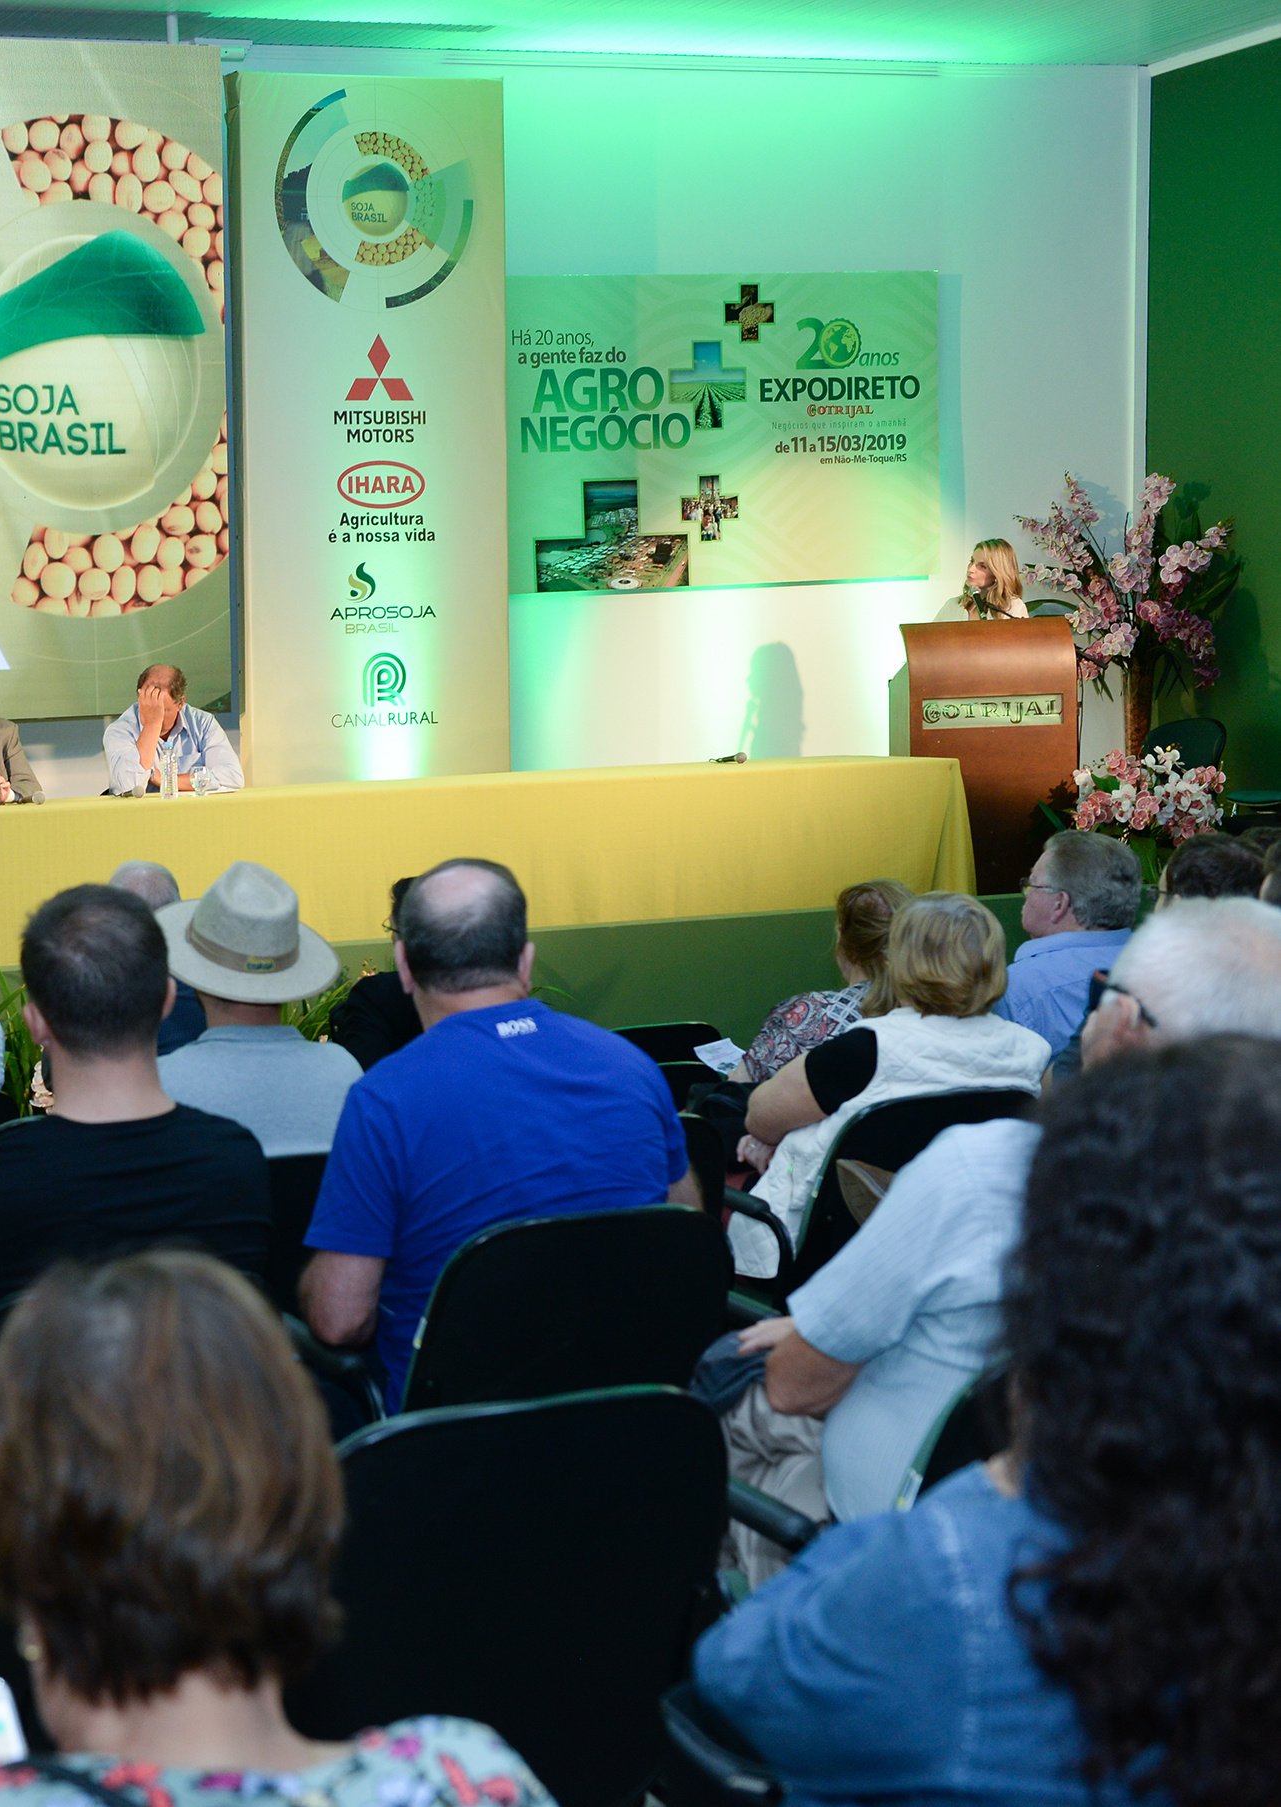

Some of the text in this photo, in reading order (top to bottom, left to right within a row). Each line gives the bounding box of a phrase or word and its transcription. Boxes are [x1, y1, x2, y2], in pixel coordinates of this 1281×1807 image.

[350, 202, 375, 211] SOJA
[352, 212, 387, 222] BRASIL
[511, 330, 595, 347] Há 20 anos,
[796, 317, 900, 370] 20 anos
[518, 346, 627, 368] a gente faz do
[532, 366, 665, 413] AGRO
[759, 375, 921, 403] EXPODIRETO
[333, 411, 426, 425] MITSUBISHI
[520, 406, 691, 453] NEGÓCIO
[772, 421, 808, 432] Negócios
[811, 422, 826, 431] que
[829, 421, 865, 430] inspiram
[347, 429, 414, 443] MOTORS
[775, 433, 907, 453] de 11 a 15/03/2019
[834, 454, 907, 464] Não-Me-Toque/RS
[347, 476, 415, 493] IHARA
[339, 513, 424, 529] Agricultura
[328, 528, 435, 543] é a nossa vida
[330, 605, 436, 620] APROSOJA
[345, 623, 399, 634] BRASIL
